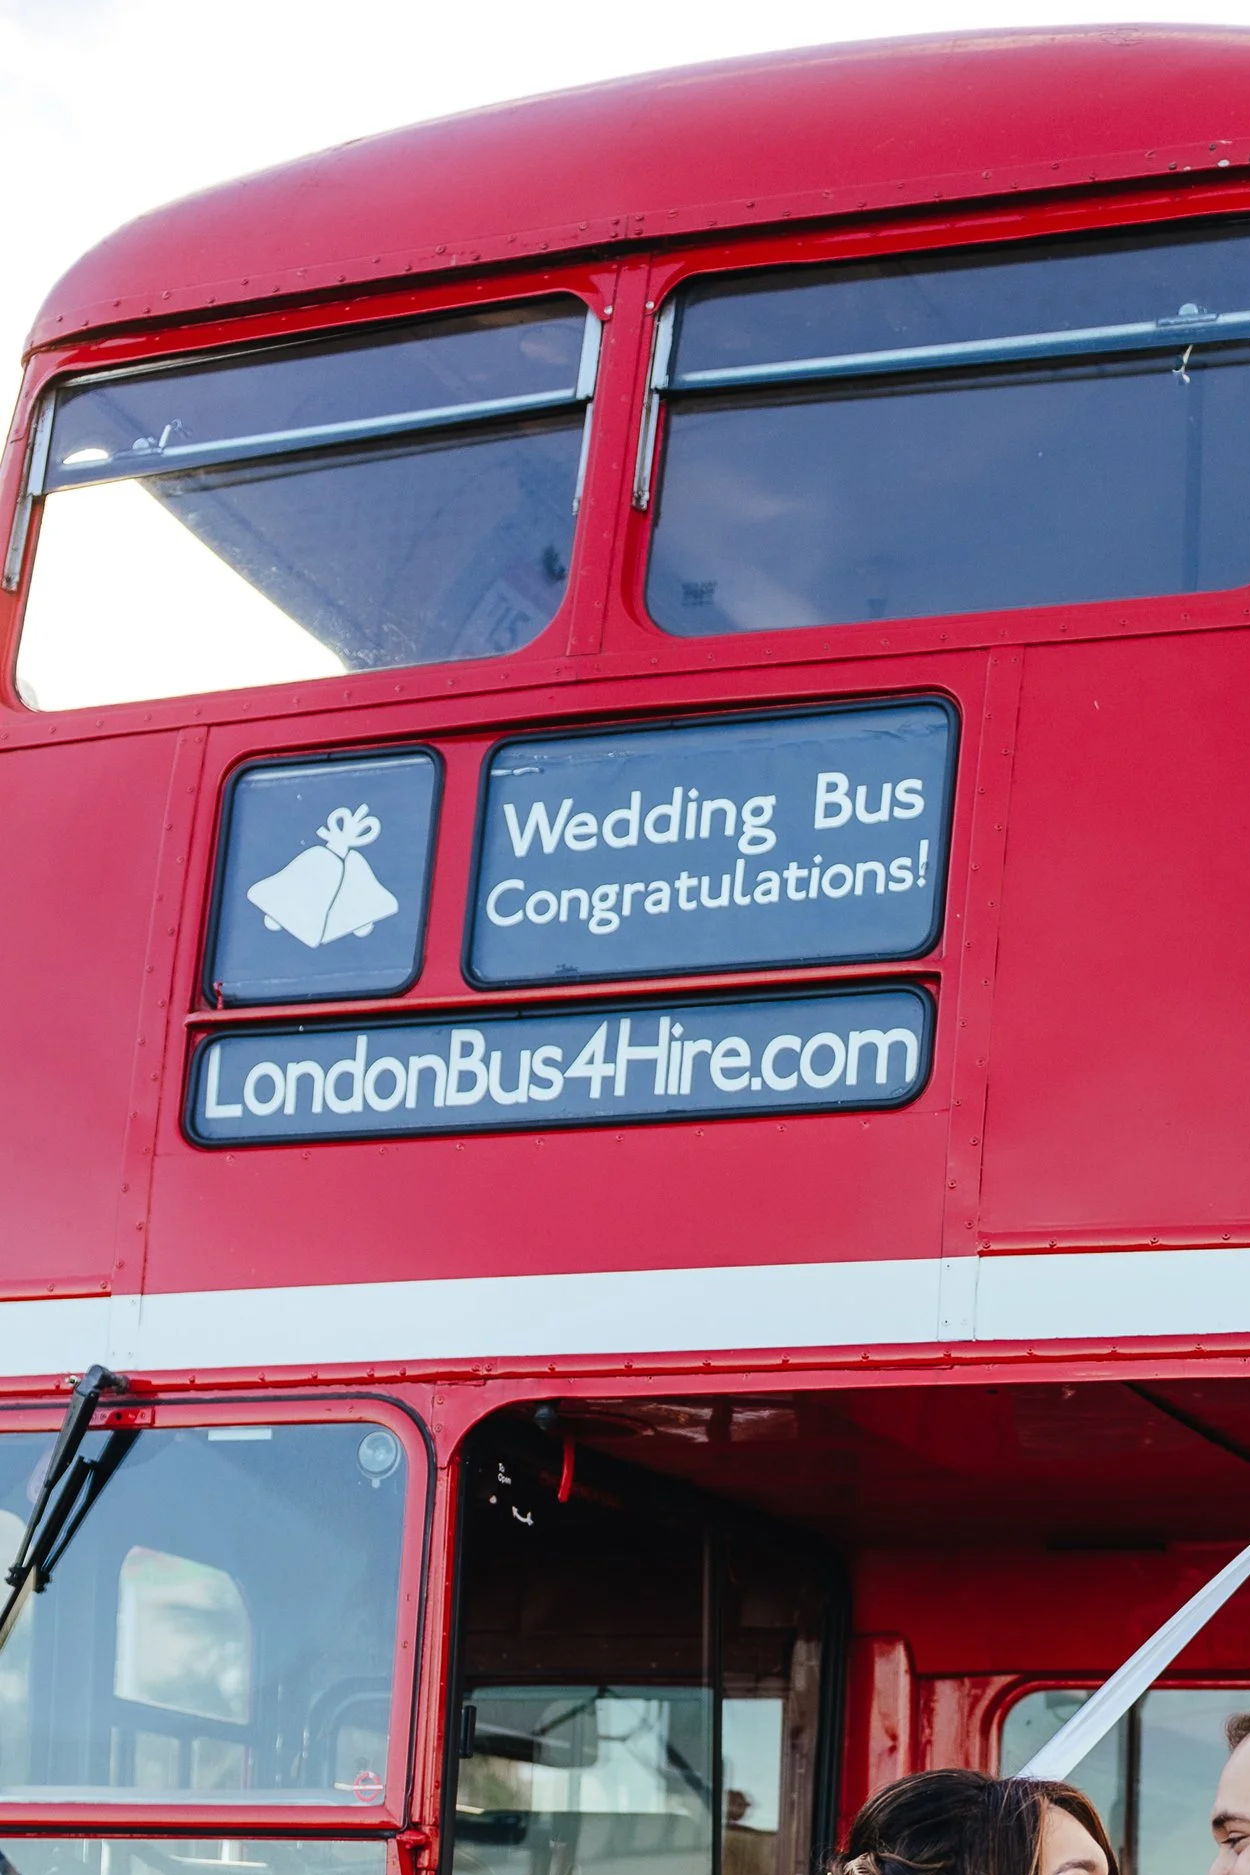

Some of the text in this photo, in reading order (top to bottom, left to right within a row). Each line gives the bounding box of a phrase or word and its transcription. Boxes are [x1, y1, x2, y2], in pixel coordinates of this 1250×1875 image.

[503, 772, 925, 858] Wedding Bus
[486, 838, 930, 935] Congratulations!
[205, 1016, 918, 1119] LondonBus4Hire.com
